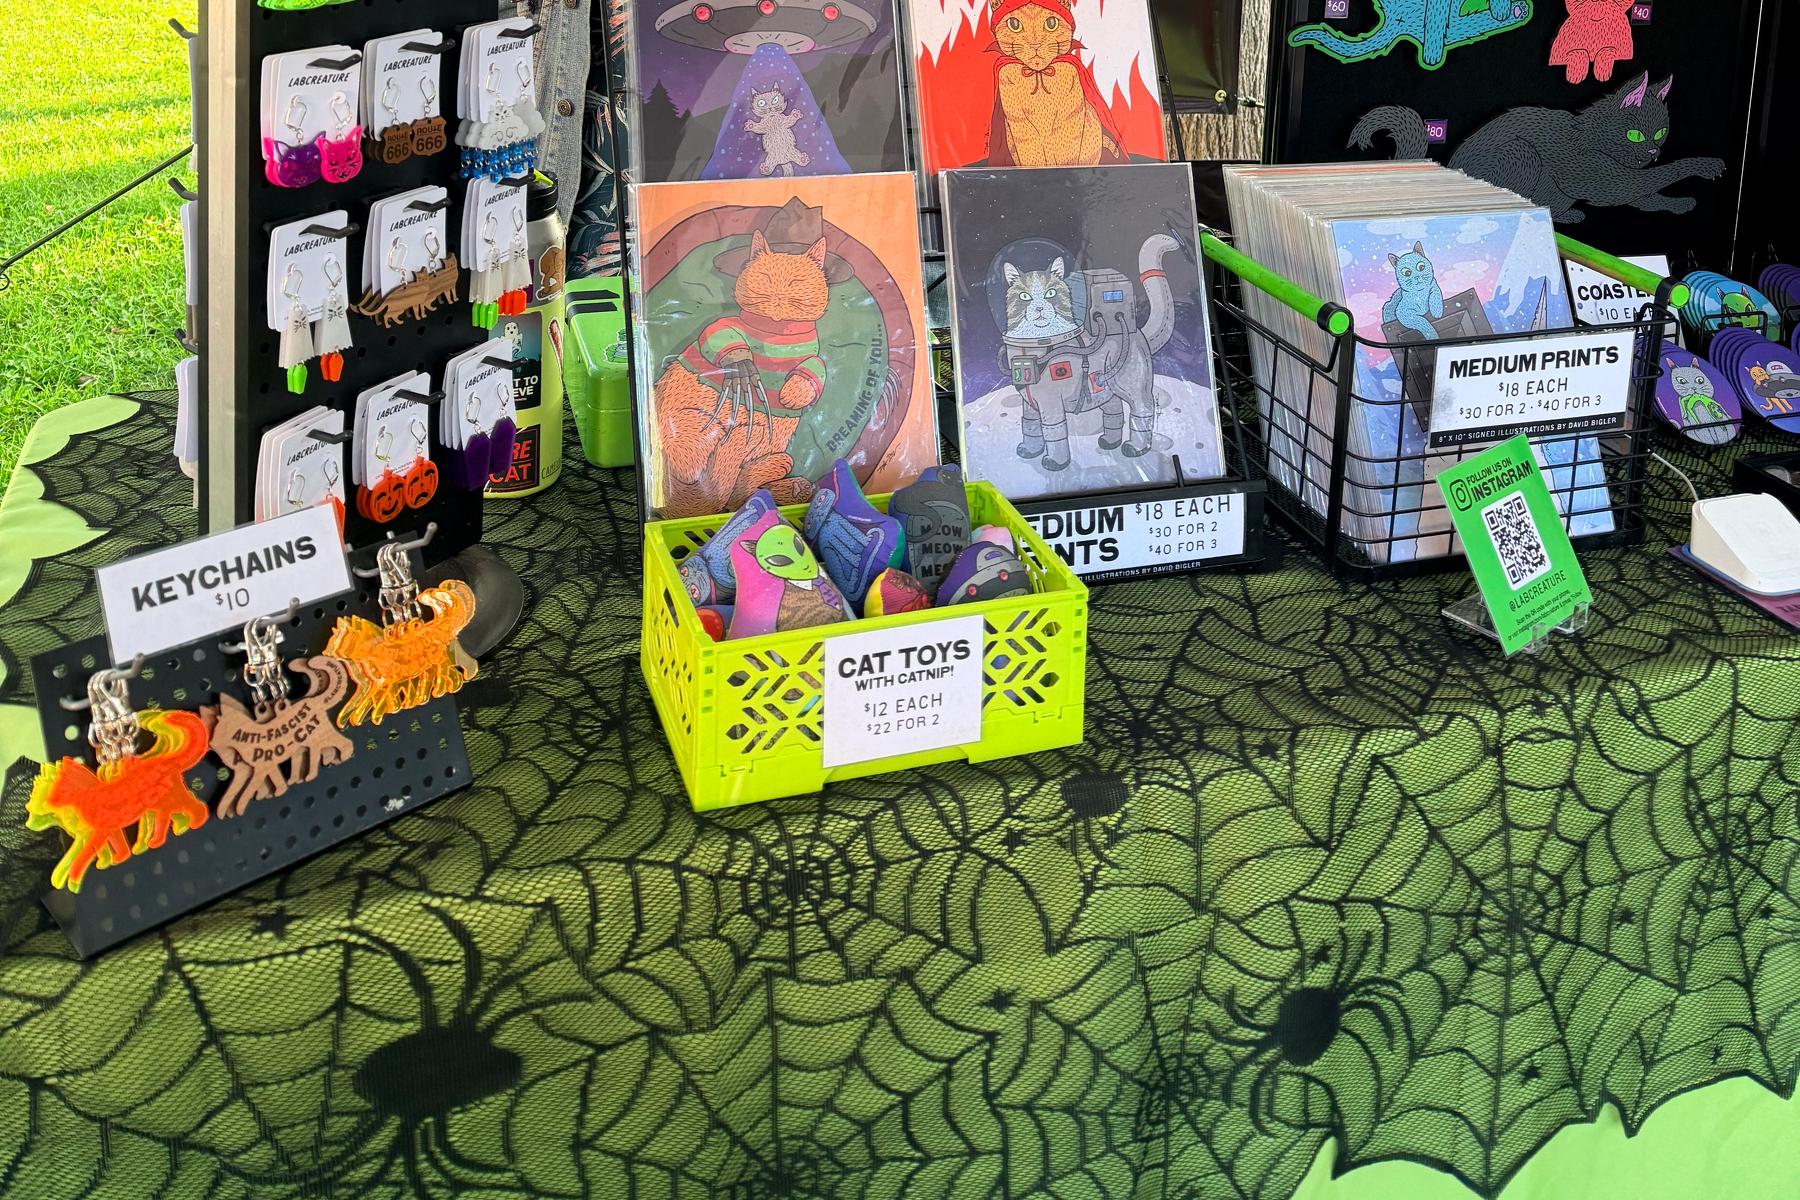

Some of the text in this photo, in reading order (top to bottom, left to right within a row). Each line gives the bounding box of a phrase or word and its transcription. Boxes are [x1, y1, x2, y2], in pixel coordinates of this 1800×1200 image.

[1327, 0, 1346, 12] $60
[1634, 6, 1649, 19] $40
[486, 38, 527, 57] LABCREATURE
[383, 54, 433, 72] LABCREATURE
[288, 72, 350, 88] LABCREATURE
[386, 142, 409, 160] 666
[416, 135, 442, 152] 666
[389, 210, 438, 232] LABCREATURE
[1599, 307, 1619, 321] $10
[1449, 346, 1619, 379] MEDIUM PRINTS
[523, 374, 539, 386] TO
[825, 323, 883, 453] DREAMING OF YOU...
[1498, 377, 1568, 398] $18 EACH
[1459, 394, 1602, 420] $30 FOR 2 $40 FOR 3
[1468, 430, 1495, 439] SIGNED
[1498, 424, 1555, 436] ILLUSTRATIONS
[1568, 420, 1589, 429] DAVID
[1591, 416, 1617, 426] BIGLER
[1466, 457, 1513, 484] FOLLOW US ON
[1470, 460, 1534, 503] INSTAGRAM
[1135, 502, 1164, 521] $18
[1175, 496, 1231, 518] EACH
[1149, 521, 1218, 538] $30 FOR 2
[922, 543, 963, 555] MEOW
[1149, 538, 1217, 556] $40 FOR 3
[131, 535, 317, 612] KEYCHAINS
[1085, 569, 1140, 581] ILLUSTRATIONS
[1153, 564, 1174, 573] DAVID
[1175, 561, 1201, 571] BIGLER
[215, 588, 250, 611] $10
[1509, 569, 1567, 612] @LABCREATURE
[838, 639, 971, 679] CAT TOYS
[855, 665, 955, 692] WITH CATNIP!
[864, 692, 943, 718] $12 EACH
[231, 702, 312, 744] ANTI-FASCIST
[867, 714, 940, 736] $22 FOR 2
[252, 714, 321, 763] PRO-CAT
